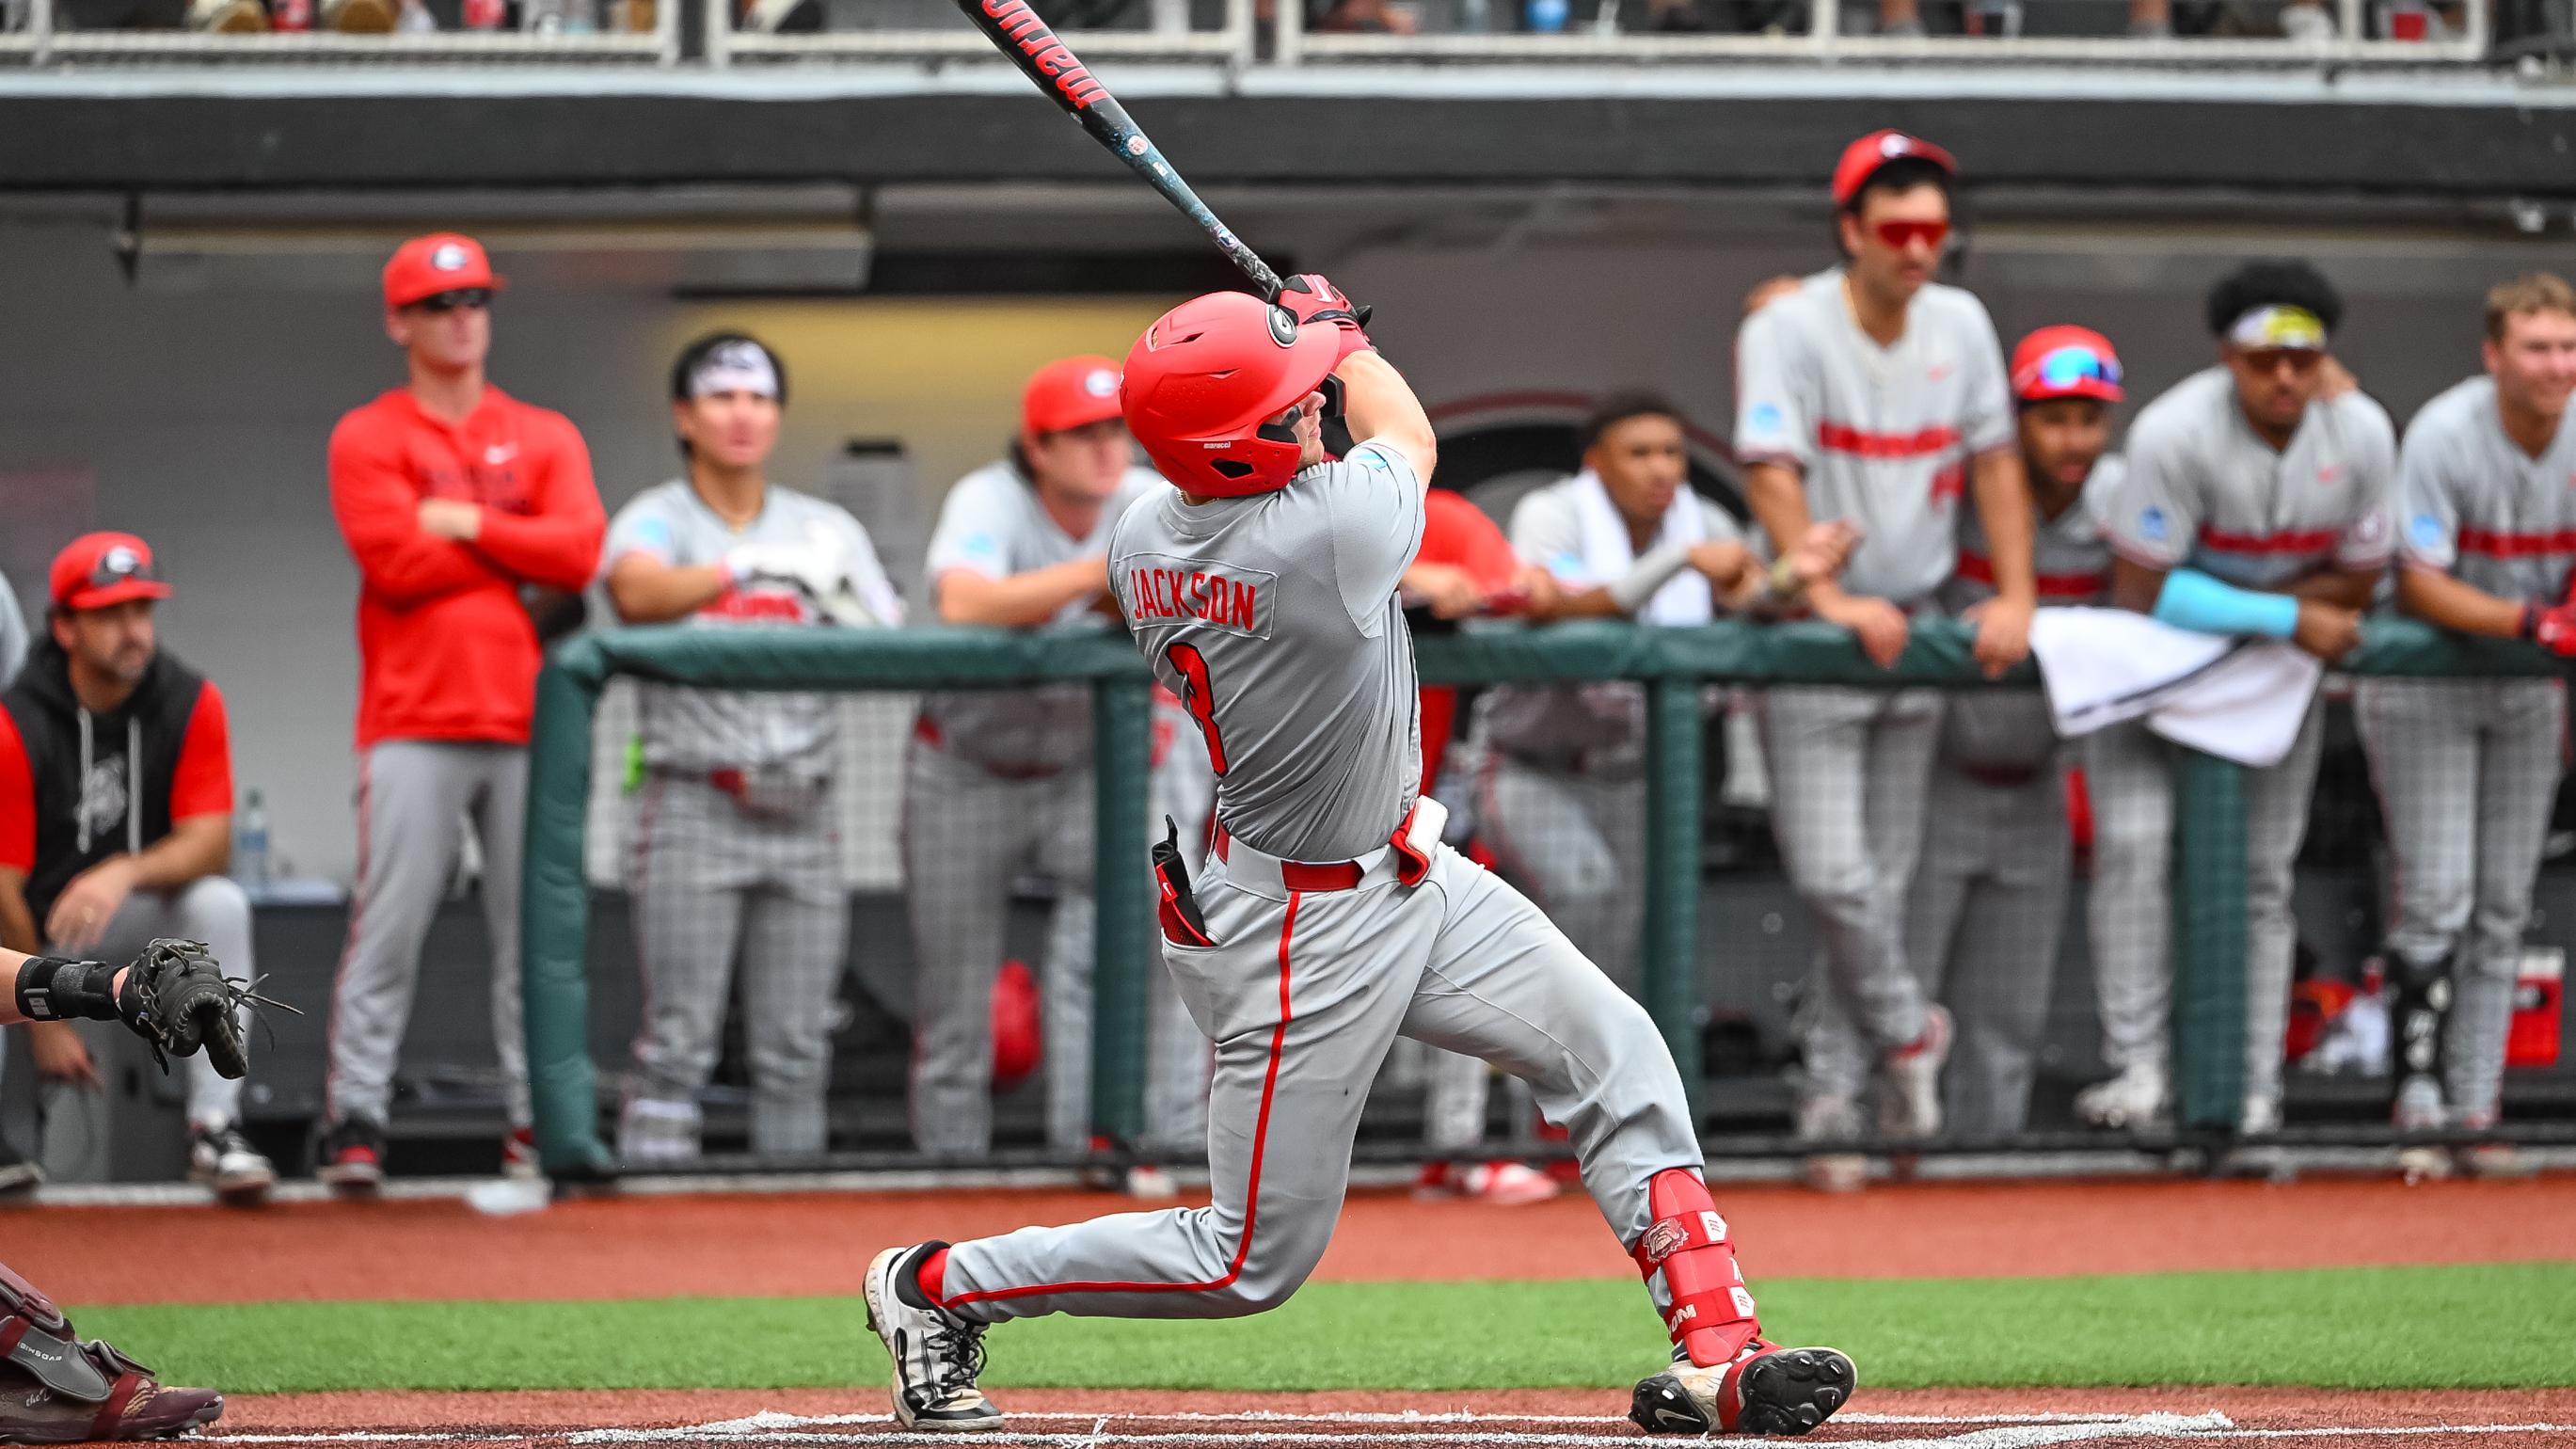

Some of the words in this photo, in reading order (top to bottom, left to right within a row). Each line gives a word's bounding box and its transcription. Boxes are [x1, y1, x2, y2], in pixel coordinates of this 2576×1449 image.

[1130, 568, 1256, 632] JACKSON
[1165, 642, 1229, 778] 3
[17, 1341, 62, 1361] EVOSHIE
